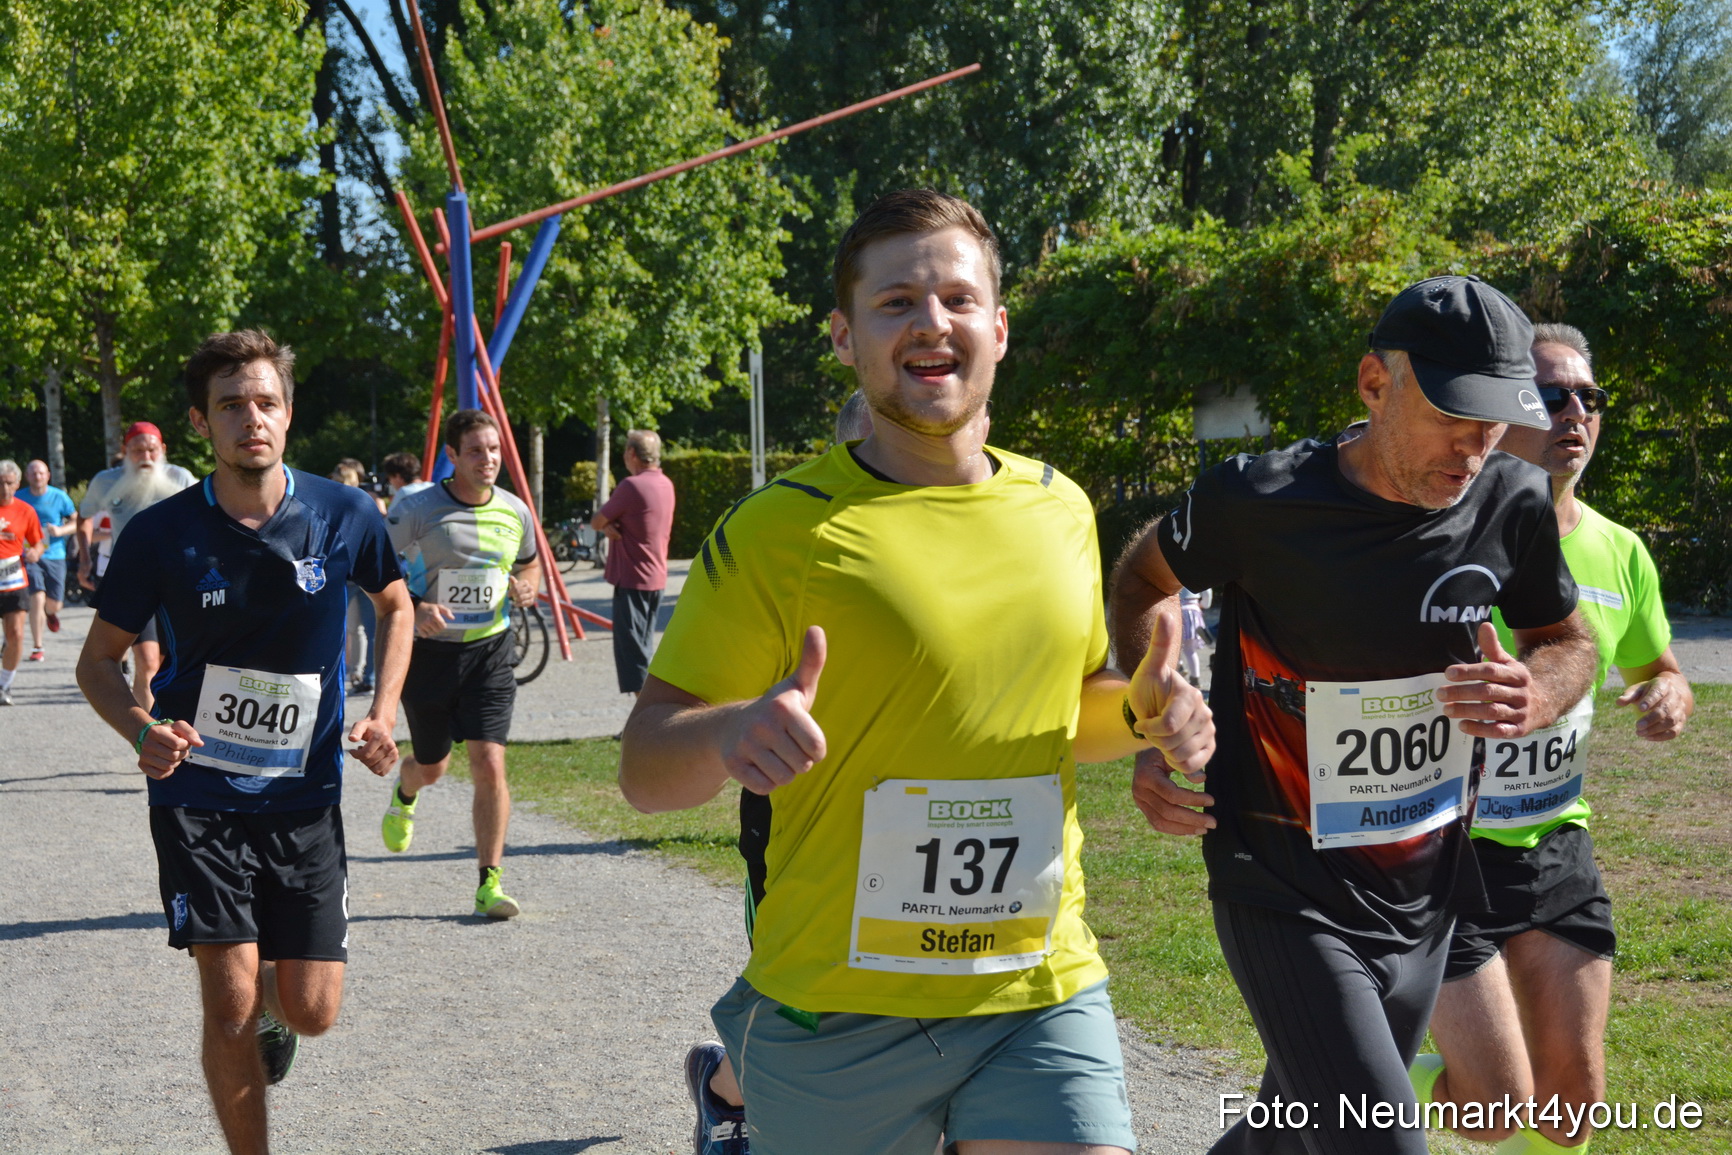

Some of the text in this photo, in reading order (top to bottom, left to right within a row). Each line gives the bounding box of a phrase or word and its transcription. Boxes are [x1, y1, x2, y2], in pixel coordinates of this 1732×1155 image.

[202, 589, 225, 608] PM
[448, 586, 493, 604] 2219
[1430, 604, 1492, 622] MAN
[240, 676, 291, 695] BOCK
[1361, 688, 1435, 714] BOCK
[215, 693, 300, 734] 3040
[218, 729, 279, 745] PARTL Neumarkt
[1336, 715, 1450, 776] 2060
[1495, 728, 1577, 778] 2164
[1319, 768, 1326, 777] B
[1350, 774, 1432, 794] PARTL Neumarkt
[1504, 774, 1564, 791] PARTL Neumarkt
[928, 798, 1013, 820] BOCK
[1359, 797, 1435, 827] Andreas
[986, 820, 1013, 828] concepts
[915, 836, 1019, 896] 137
[869, 878, 877, 888] C
[902, 902, 1005, 916] PARTL Neumarkt
[920, 927, 995, 953] Stefan
